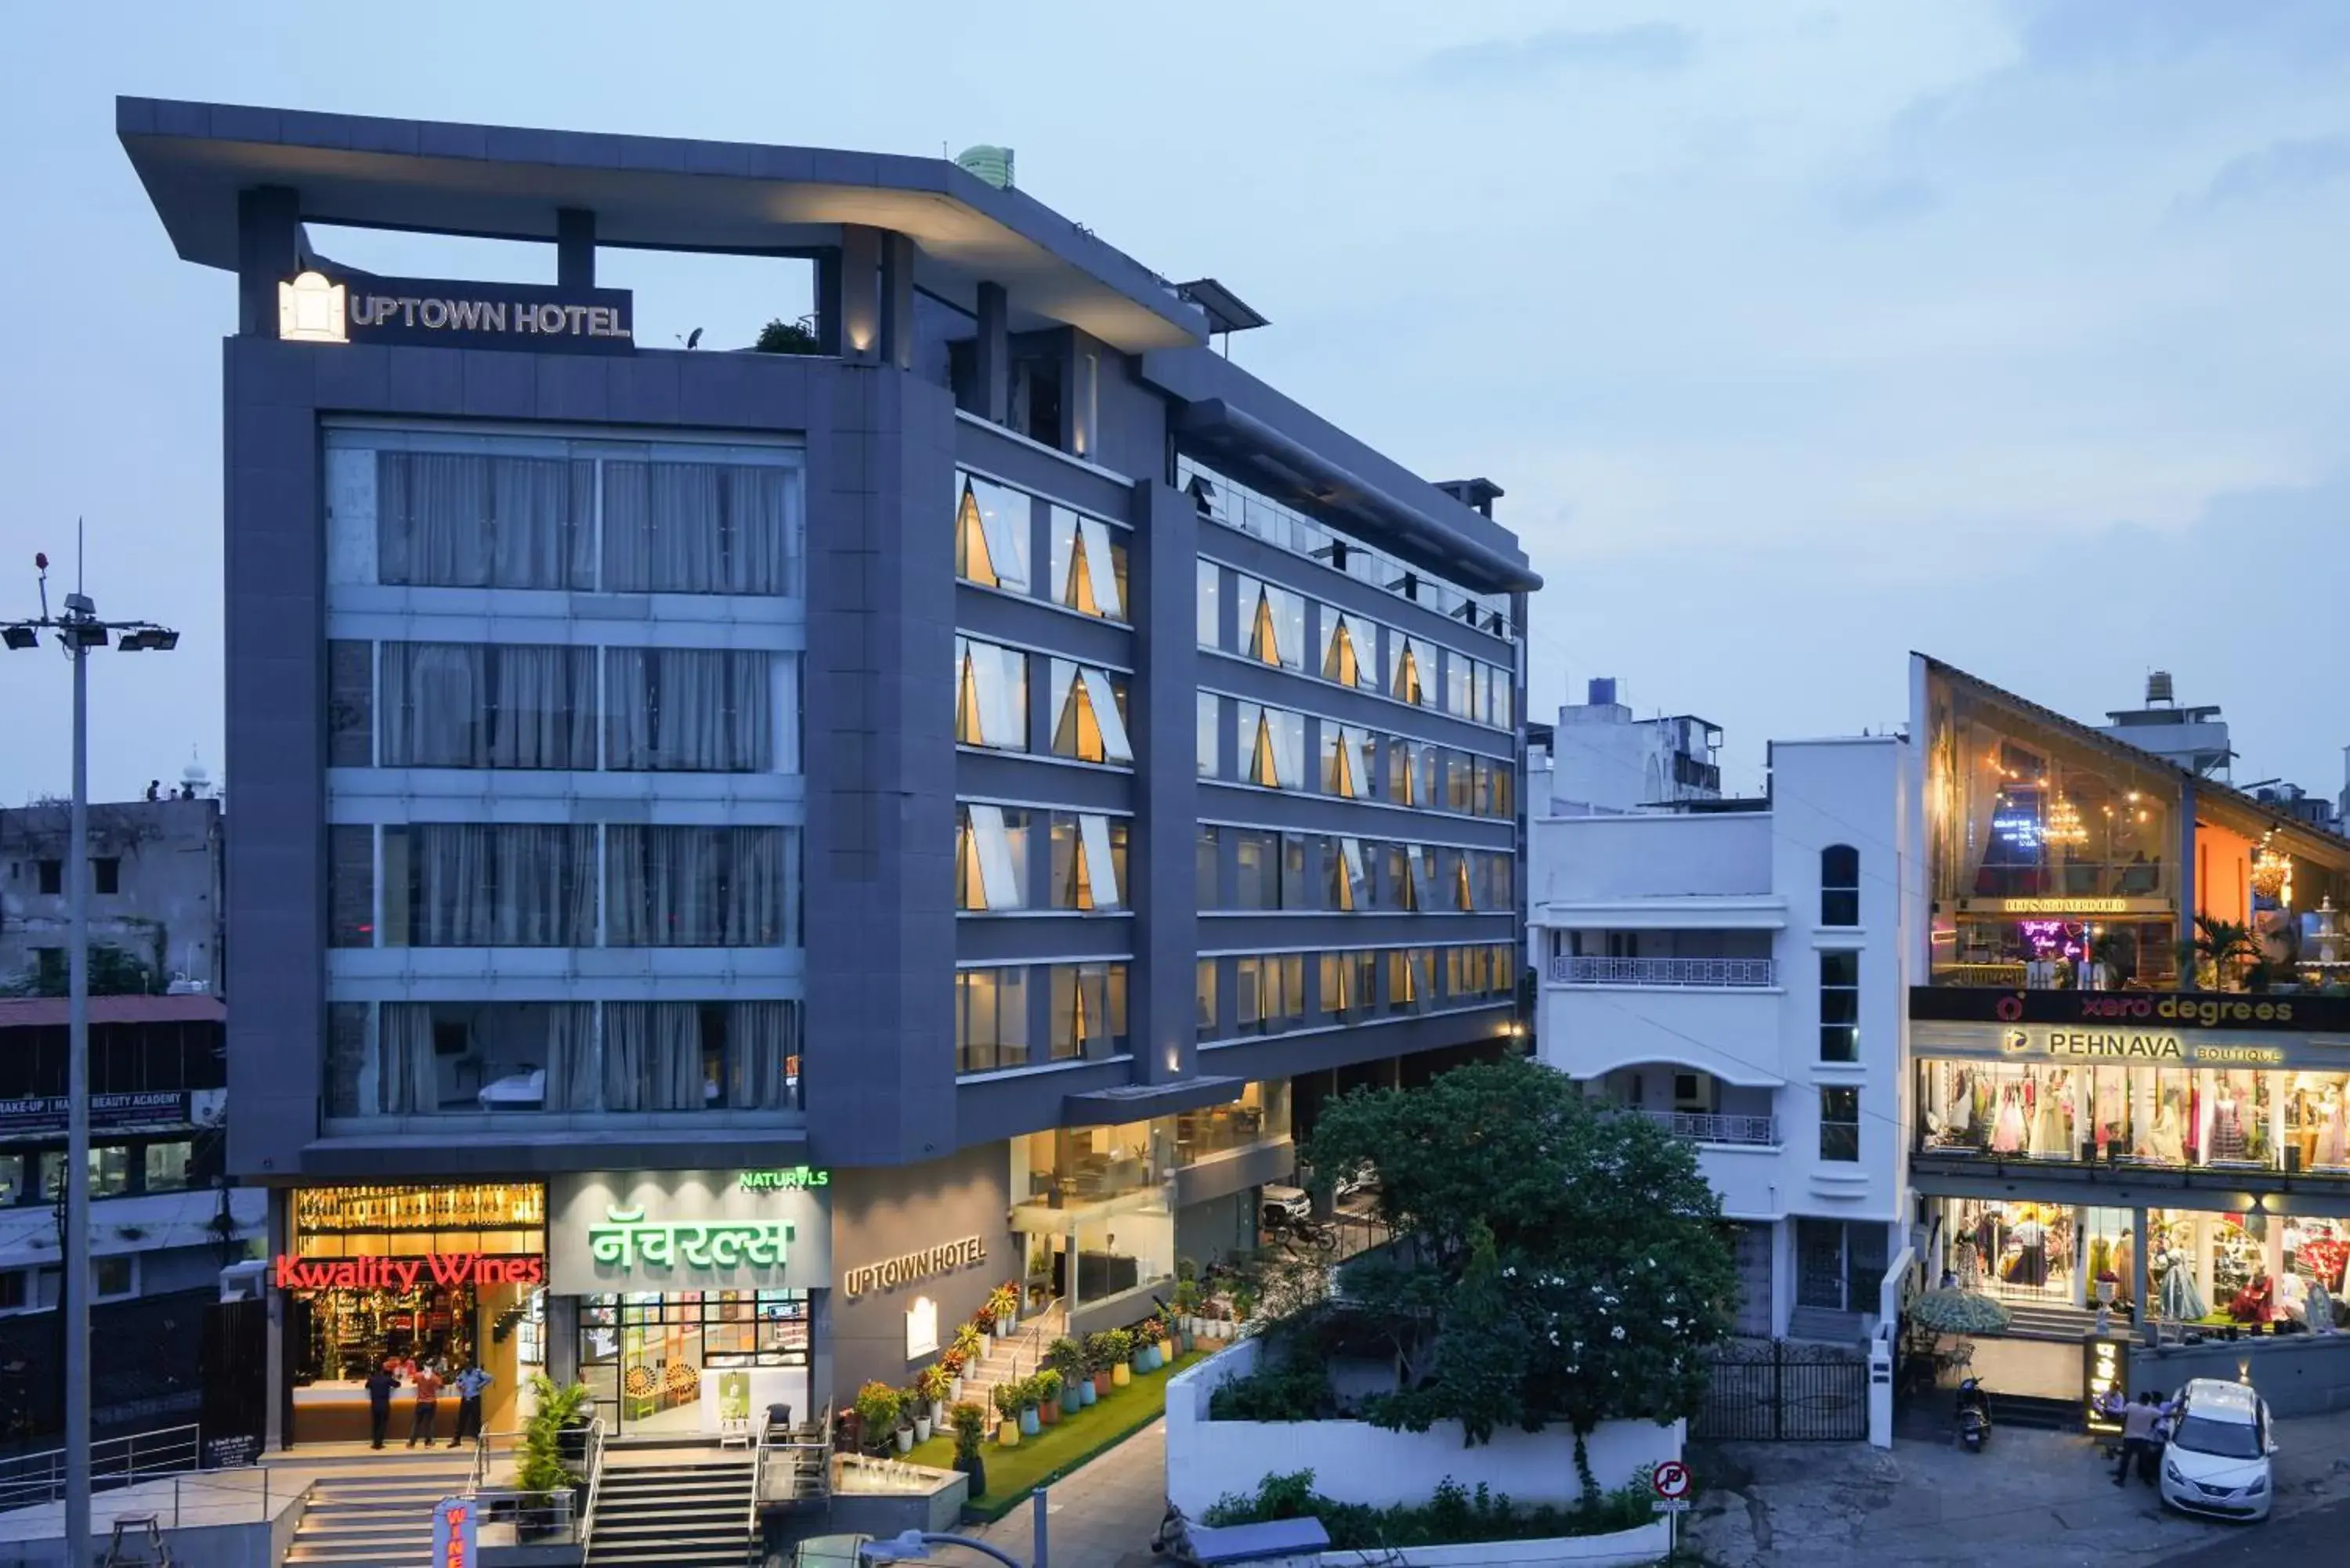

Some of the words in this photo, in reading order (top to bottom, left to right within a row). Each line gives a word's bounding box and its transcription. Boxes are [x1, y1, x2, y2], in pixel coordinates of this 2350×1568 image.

[350, 294, 506, 332] UPTOWN
[515, 303, 631, 338] HOTEL
[2157, 995, 2294, 1027] degrees
[2049, 1032, 2182, 1058] PEHNAVA
[92, 1095, 131, 1108] BEAUTY
[132, 1093, 181, 1105] ACADEMY
[275, 1254, 421, 1294] Kwality
[425, 1251, 544, 1285] Wines
[844, 1249, 929, 1299] UPTOWN
[931, 1234, 987, 1273] HOTEL
